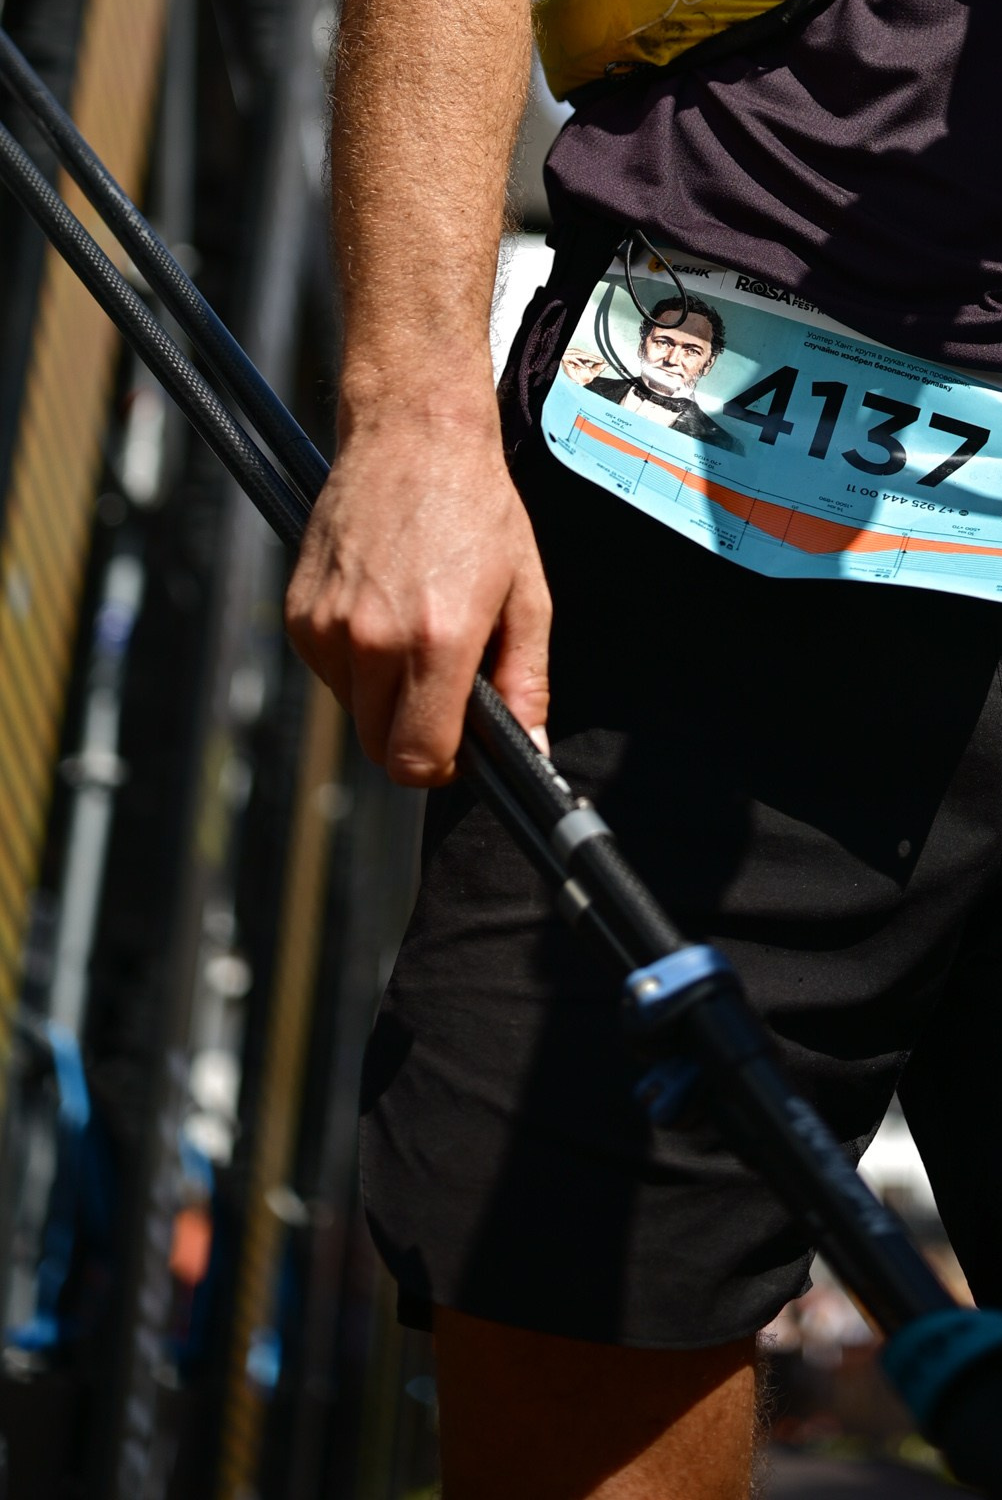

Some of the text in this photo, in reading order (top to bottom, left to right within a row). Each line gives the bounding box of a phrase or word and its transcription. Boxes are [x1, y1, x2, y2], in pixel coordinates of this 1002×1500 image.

[672, 264, 712, 279] БАНК
[735, 275, 791, 306] ROSA
[791, 299, 816, 313] FEST
[804, 341, 953, 392] случайно изобрел безопасную булавку
[807, 331, 833, 346] Уолтер
[835, 340, 853, 350] Хант,
[855, 347, 876, 359] крутя
[884, 356, 905, 367] руках
[907, 362, 928, 374] кусок
[721, 365, 991, 488] 4137
[846, 483, 955, 514] +7 925 444 00 11
